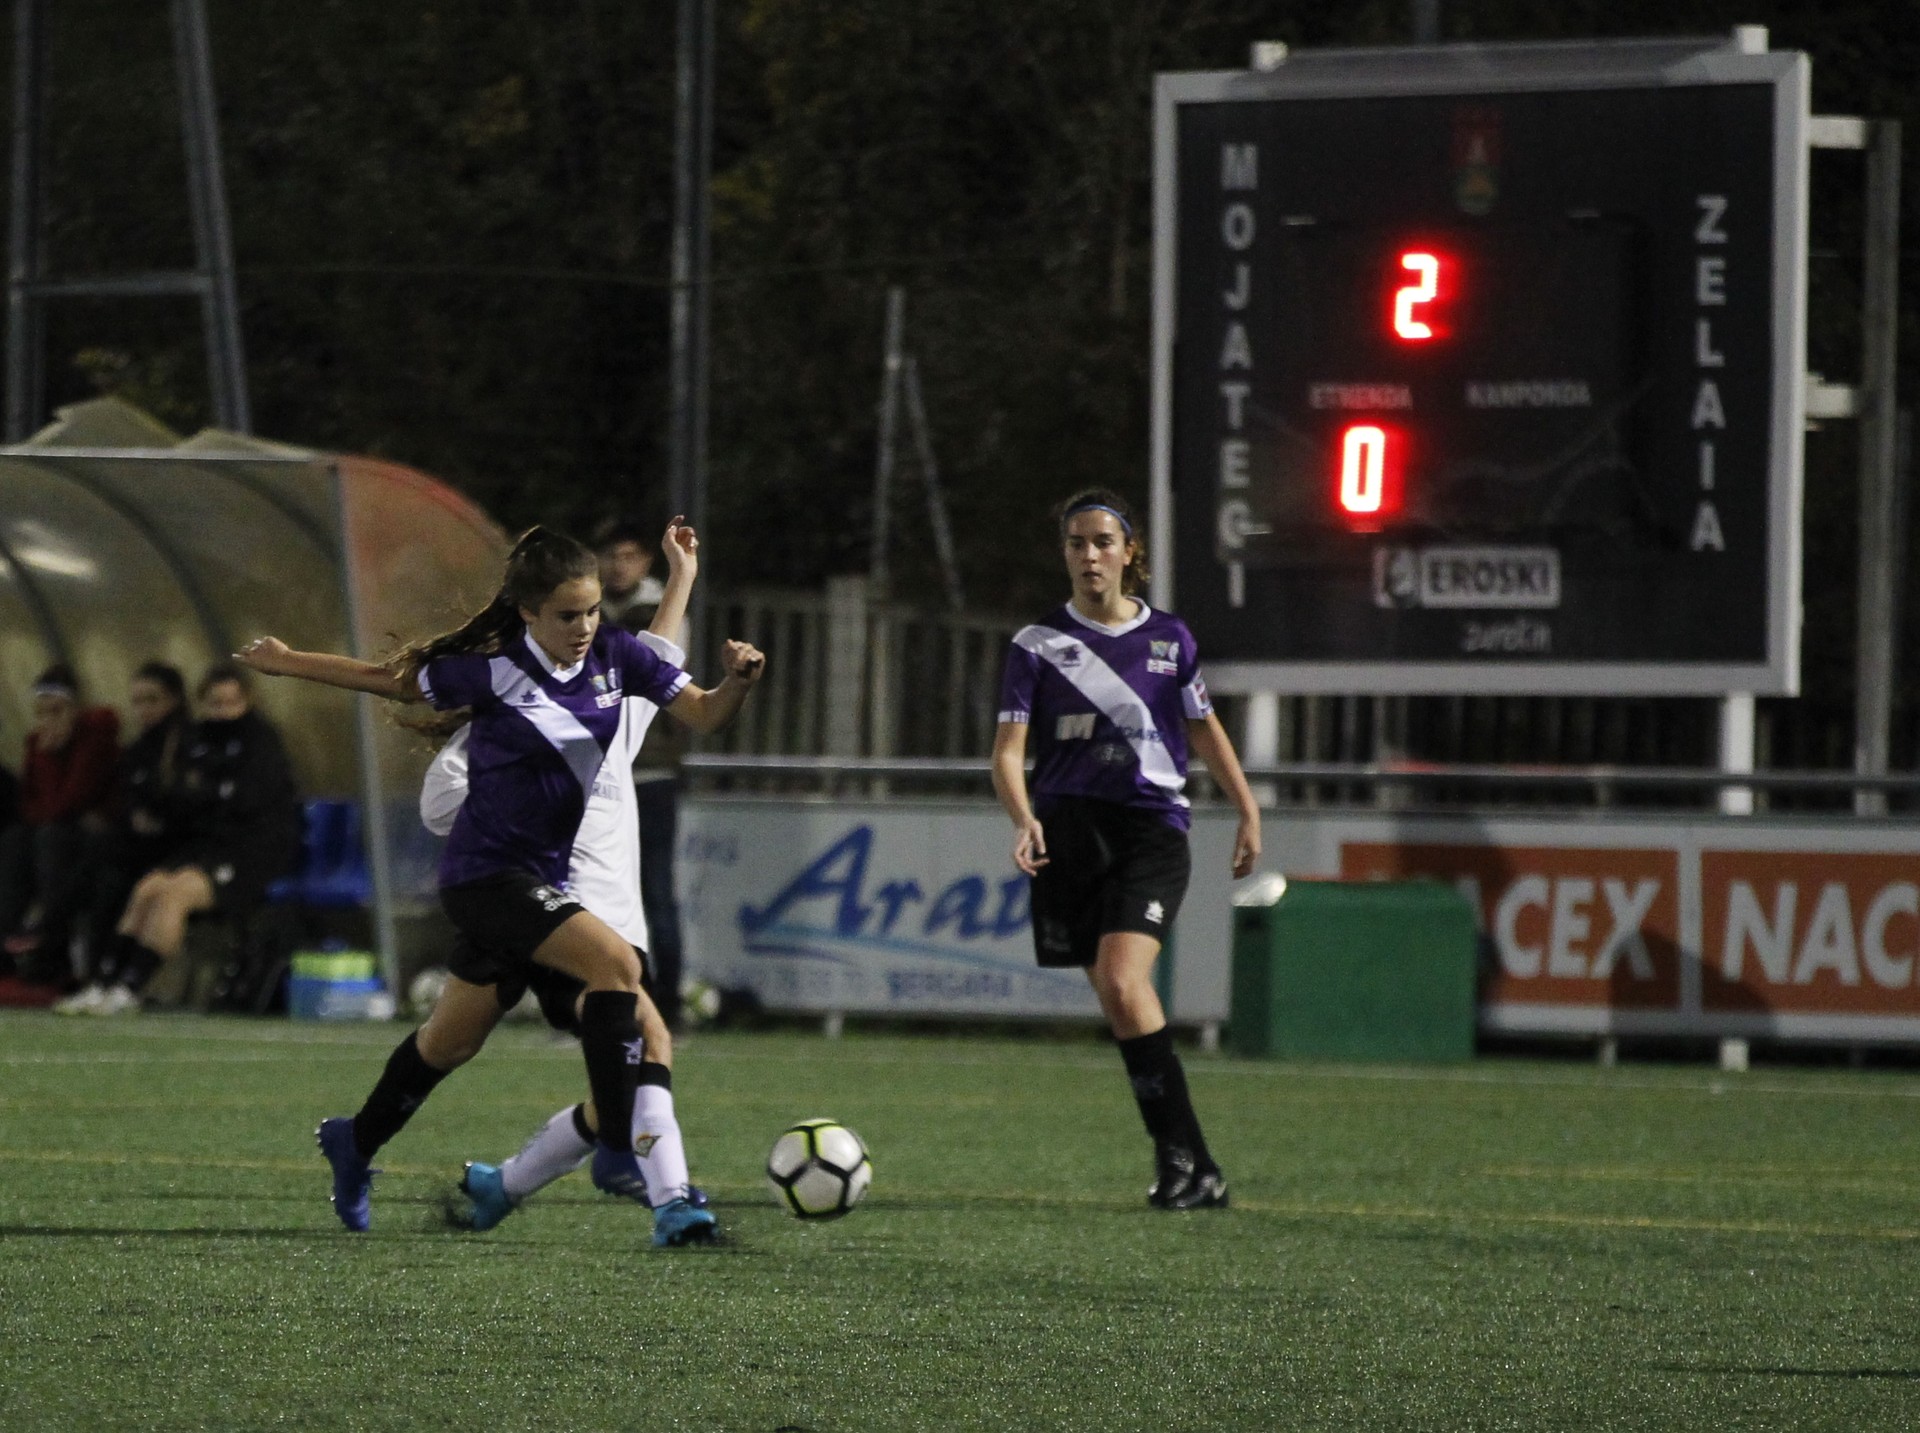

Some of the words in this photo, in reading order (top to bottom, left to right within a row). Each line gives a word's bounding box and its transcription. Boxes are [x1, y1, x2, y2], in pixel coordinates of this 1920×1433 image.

[1394, 253, 1439, 339] 2
[1219, 143, 1259, 608] MOJATEGI
[1691, 195, 1728, 551] ZELAIA
[1340, 425, 1386, 513] 0
[1428, 560, 1549, 594] EROSKI
